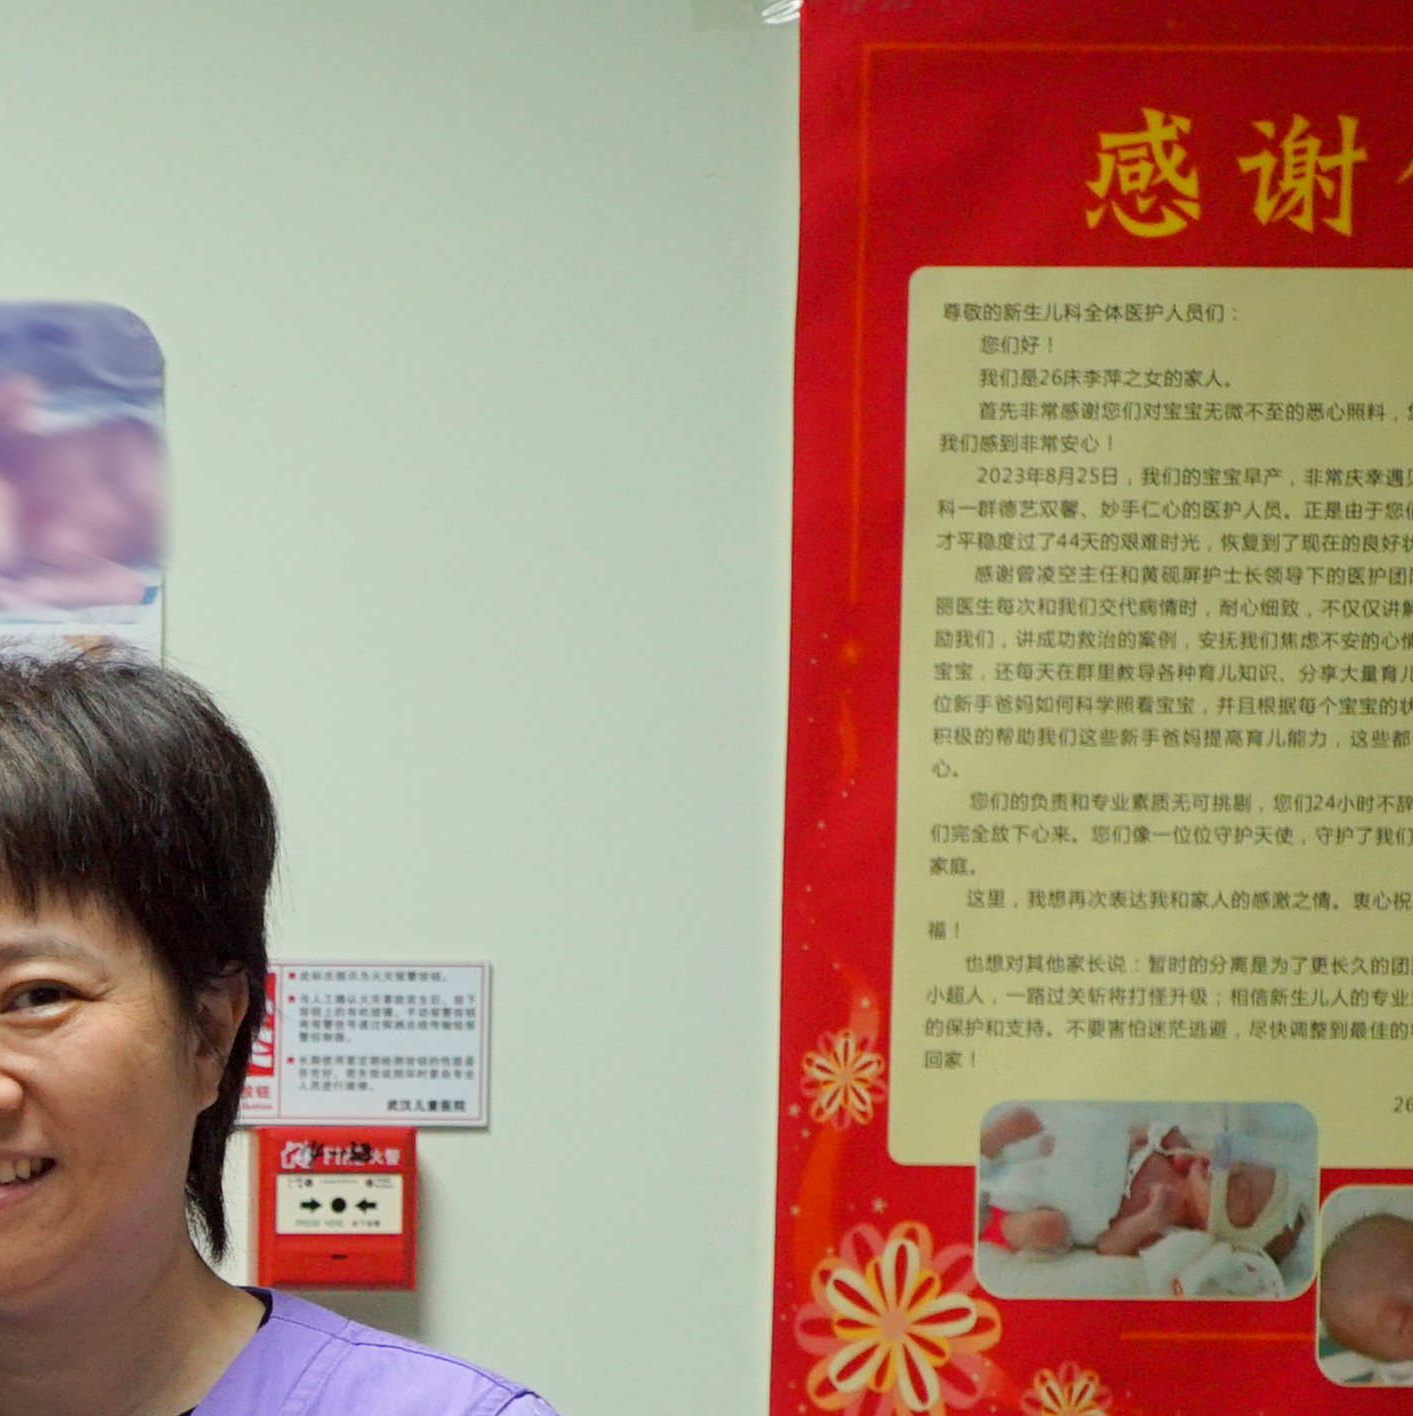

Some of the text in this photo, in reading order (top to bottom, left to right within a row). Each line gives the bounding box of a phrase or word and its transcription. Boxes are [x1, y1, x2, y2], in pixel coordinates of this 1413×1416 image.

[1085, 107, 1413, 239] 感谢
[980, 335, 1054, 355] 您们好！
[978, 400, 1413, 422] 首先非常感谢您们对宝宝无微不至的悉心照料，
[939, 433, 1114, 455] 我们感到非常安心！
[974, 563, 1413, 586] 感谢曾凌空主任和黄砚屏护士长领导下的医护团
[931, 758, 959, 779] 心。
[929, 856, 977, 877] 家庭。
[927, 921, 961, 941] 福！
[965, 953, 1413, 976] 也想对其他家长说：暂时的分离是为了更长久的团
[925, 1017, 1413, 1040] 的保护和支持。不要害怕迷茫逃避，尽快调整到最佳的
[923, 1050, 977, 1070] 回家！
